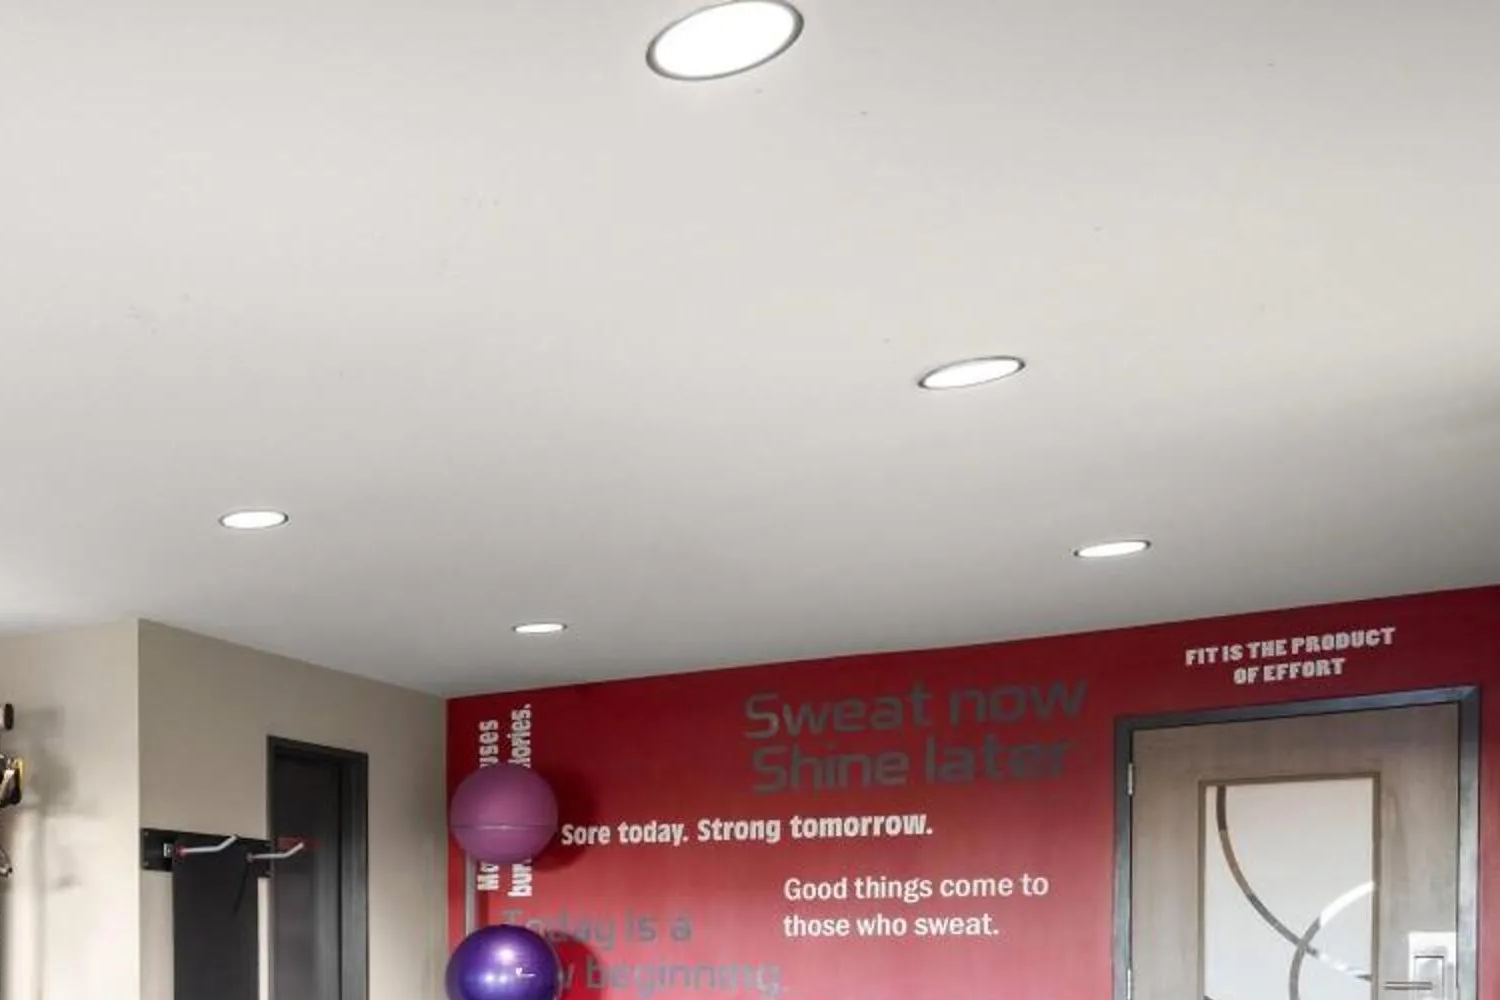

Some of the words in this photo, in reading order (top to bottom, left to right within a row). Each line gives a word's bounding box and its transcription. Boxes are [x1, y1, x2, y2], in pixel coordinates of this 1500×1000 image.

[1185, 646, 1219, 666] FIT
[1222, 644, 1244, 662] IS
[1247, 639, 1288, 659] THE
[1291, 627, 1396, 654] PRODUCT
[1233, 667, 1259, 685] OF
[1263, 657, 1346, 682] EFFORT
[743, 681, 934, 740] Sweat
[949, 678, 1090, 728] now
[753, 743, 910, 796] Shine
[925, 734, 1076, 783] later
[561, 823, 611, 845] Sore
[617, 820, 689, 847] today.
[697, 816, 780, 844] Strong
[790, 814, 933, 839] tomorrow.
[784, 877, 848, 901] Good
[854, 876, 933, 903] things
[940, 876, 1013, 897] come
[1019, 873, 1049, 896] to
[671, 914, 693, 942] a
[783, 914, 850, 937] those
[856, 914, 907, 936] who
[914, 913, 1000, 936] sweat.
